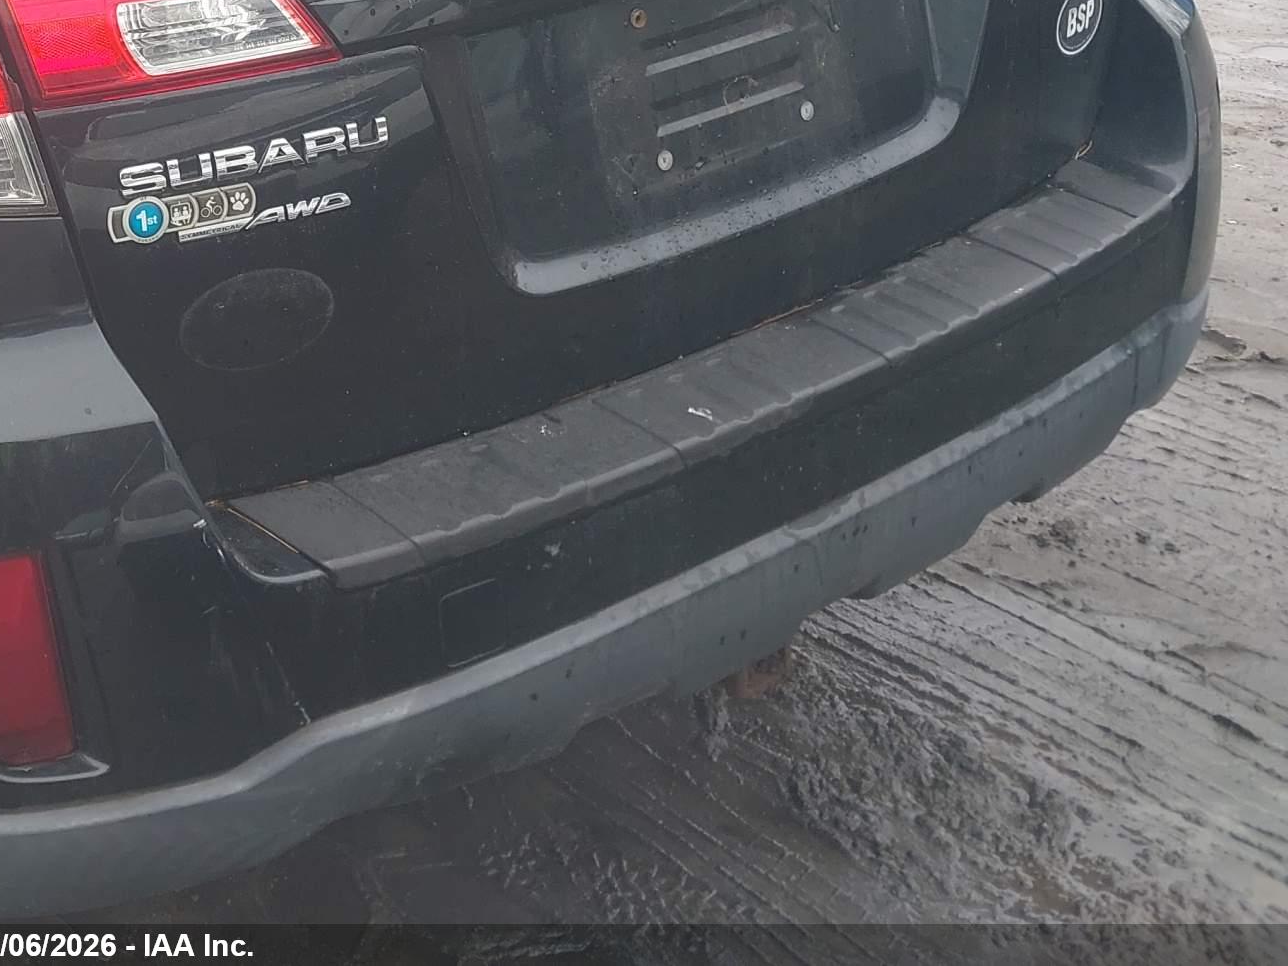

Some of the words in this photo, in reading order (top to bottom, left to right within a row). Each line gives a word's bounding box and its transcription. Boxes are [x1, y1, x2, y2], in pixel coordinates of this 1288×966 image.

[118, 116, 389, 197] SUBARU
[135, 210, 158, 232] 1st
[245, 192, 352, 231] AWD
